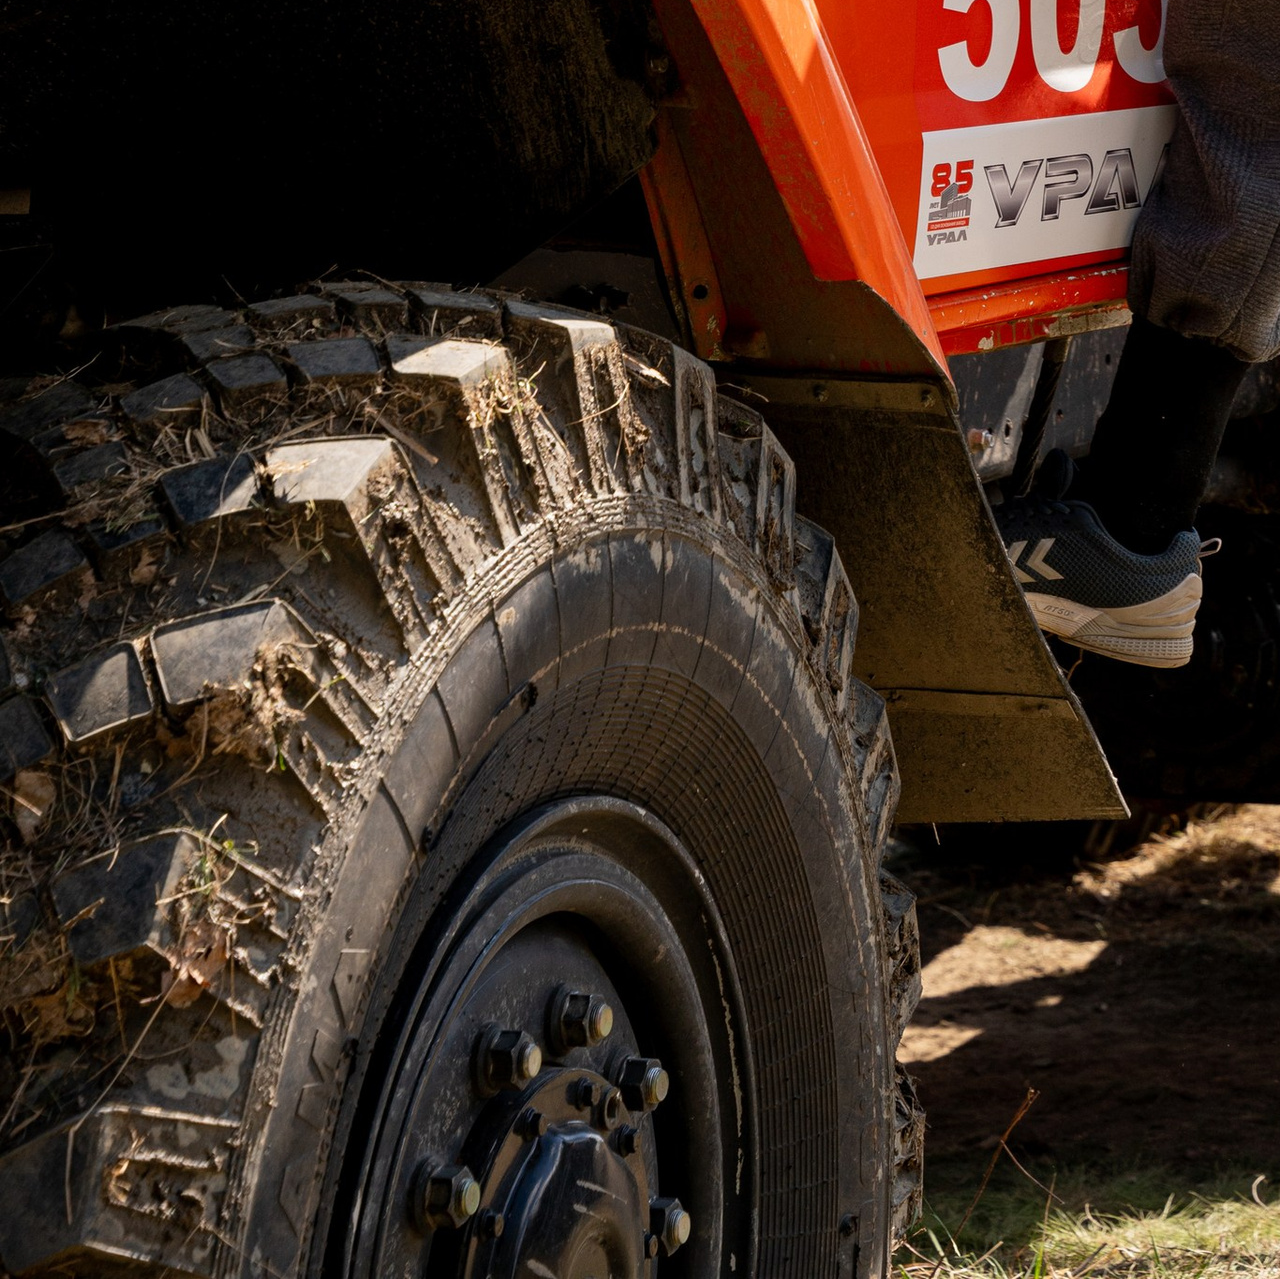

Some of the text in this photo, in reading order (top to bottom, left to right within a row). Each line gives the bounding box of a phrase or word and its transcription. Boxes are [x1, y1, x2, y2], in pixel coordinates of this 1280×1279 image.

[931, 159, 975, 198] 85
[983, 143, 1170, 229] УРА
[926, 229, 968, 247] УРАЛ
